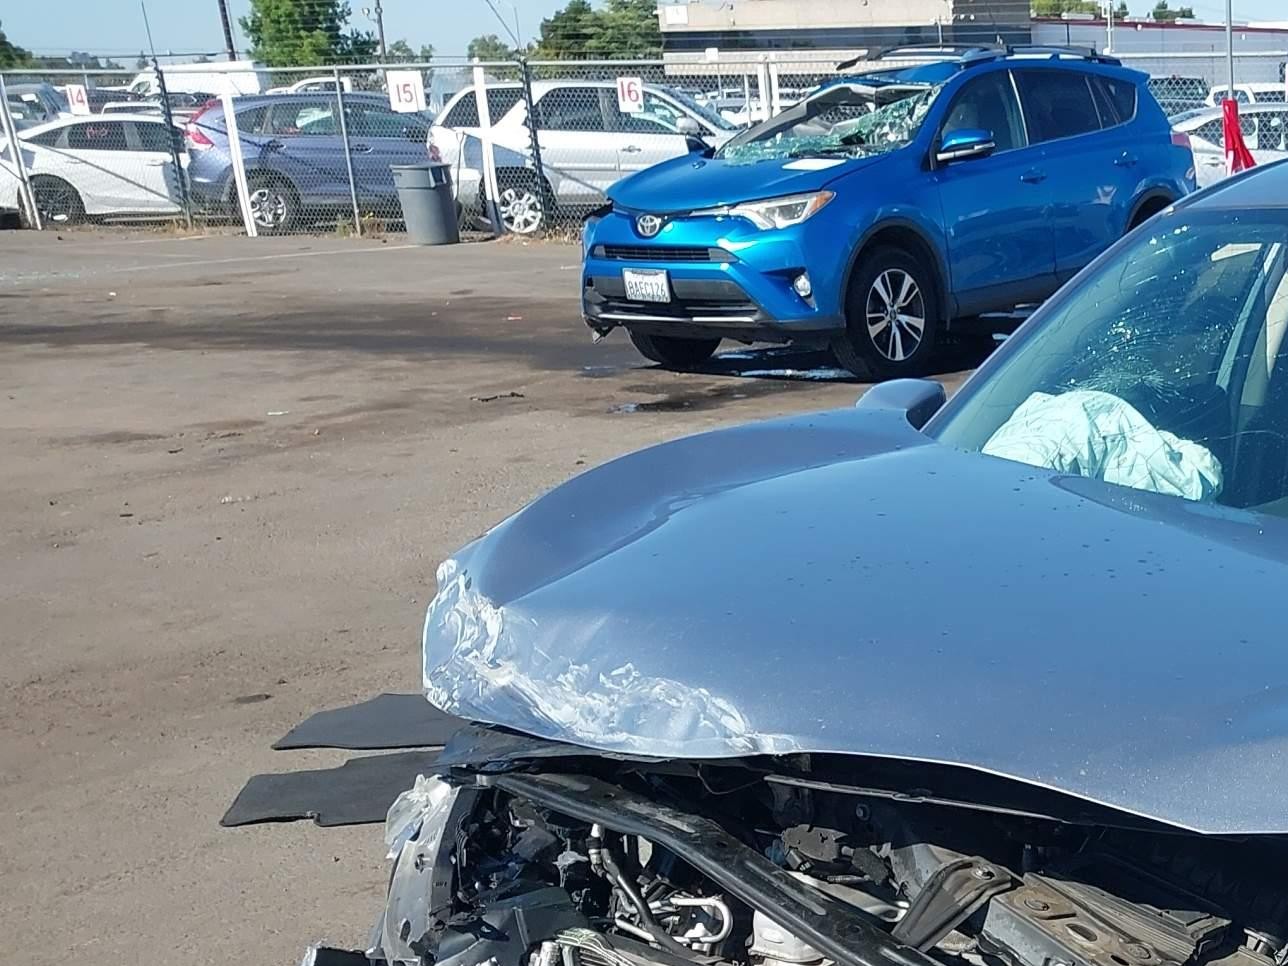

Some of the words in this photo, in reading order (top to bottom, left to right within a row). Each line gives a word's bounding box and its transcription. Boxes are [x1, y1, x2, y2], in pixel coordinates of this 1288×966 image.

[69, 87, 86, 106] 14
[396, 83, 414, 103] 15
[620, 81, 639, 102] 16
